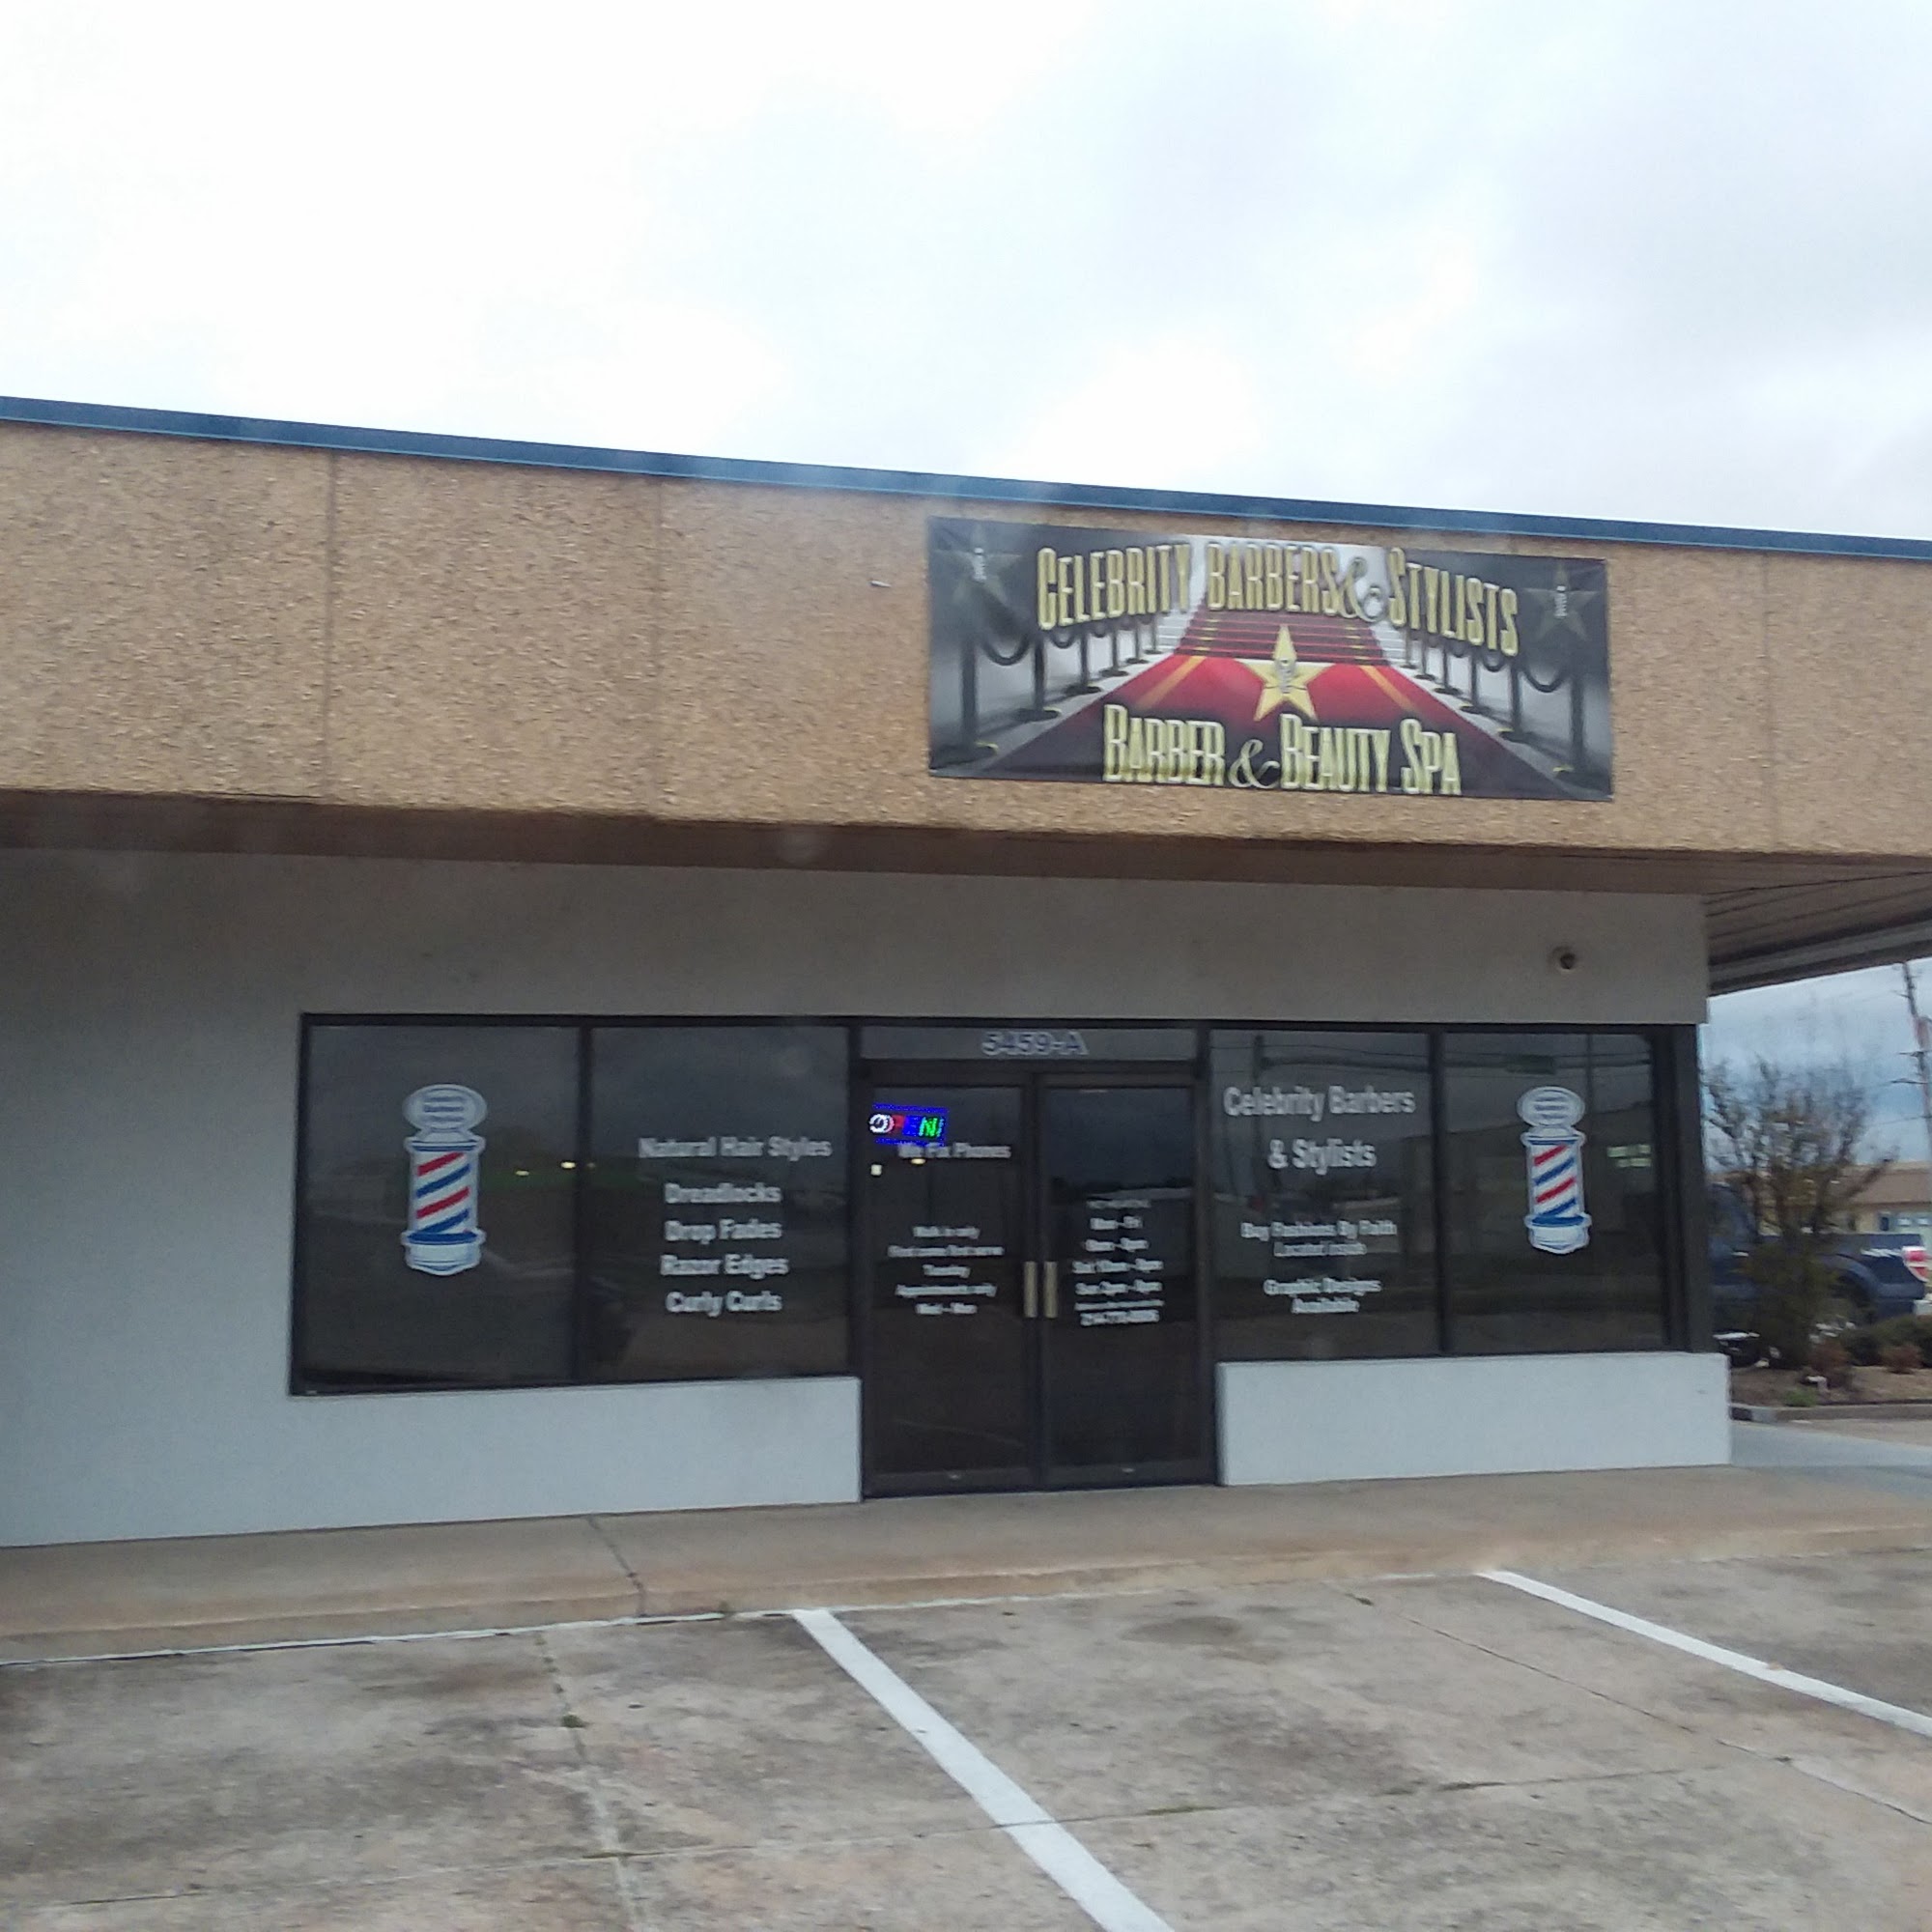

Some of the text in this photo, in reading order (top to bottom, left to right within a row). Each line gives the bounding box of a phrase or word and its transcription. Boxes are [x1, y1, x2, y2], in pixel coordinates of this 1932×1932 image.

[1037, 542, 1520, 658] CELEBRITY BARBERS & STYLISTS
[1102, 702, 1463, 796] BARBER & BEAUTY SPA
[1223, 1085, 1416, 1122] Celebrity Barbers
[1267, 1138, 1378, 1176] & Stylists
